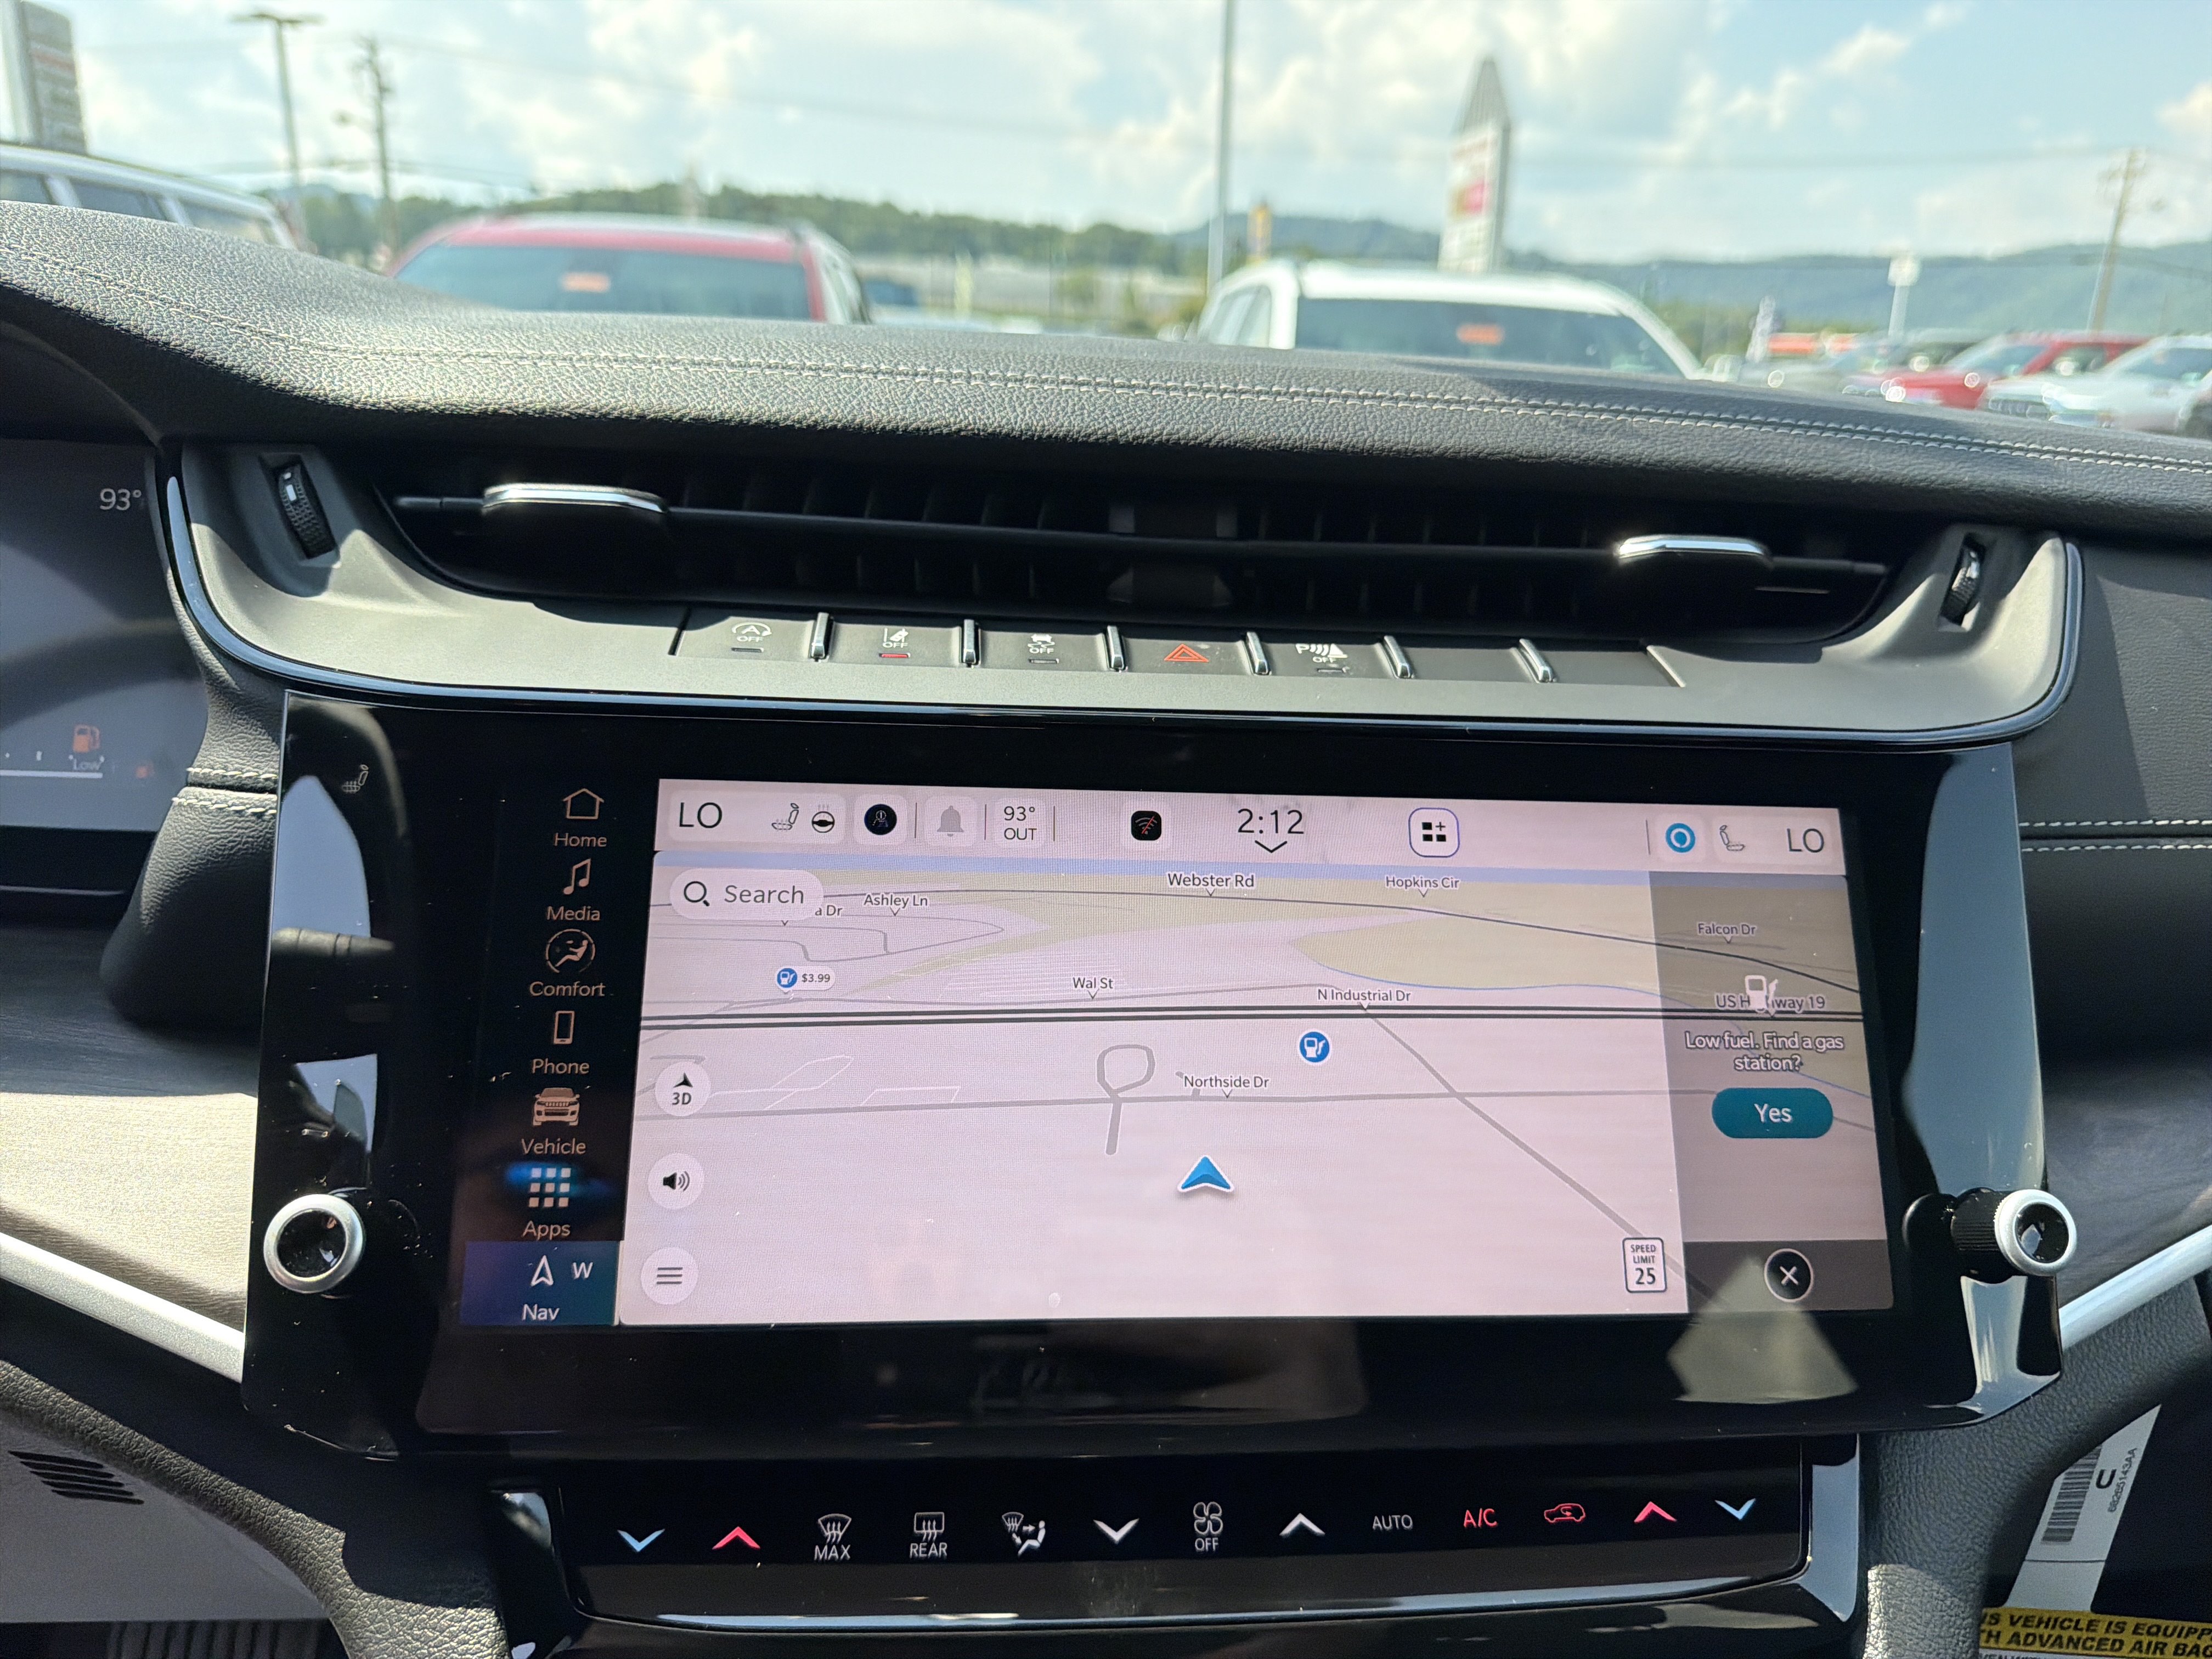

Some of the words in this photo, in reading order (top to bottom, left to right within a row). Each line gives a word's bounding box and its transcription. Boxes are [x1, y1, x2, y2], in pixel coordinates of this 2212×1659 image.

[100, 489, 141, 510] 93°
[679, 803, 722, 828] LO
[1004, 806, 1035, 821] 93°
[1238, 809, 1304, 834] 2:12
[555, 833, 607, 847] Home
[1004, 828, 1037, 840] OUT
[1787, 828, 1824, 853] LO
[1168, 873, 1231, 887] Webster
[1235, 875, 1254, 887] Rd
[1386, 877, 1438, 890] Hopkins
[1442, 878, 1459, 888] Cir
[725, 885, 803, 904] Search
[864, 894, 909, 909] Ashley
[912, 894, 928, 906] Ln
[548, 906, 600, 921] Media
[827, 905, 842, 916] Dr
[1699, 923, 1737, 934] Falcon
[1742, 924, 1755, 934] Dr
[802, 974, 830, 983] $3.99
[1073, 978, 1096, 988] Wal
[1101, 978, 1113, 989] St
[530, 981, 605, 996] Comfort
[1318, 990, 1325, 1000] N
[1331, 989, 1392, 1001] Industrial
[1396, 990, 1410, 1001] Dr
[1717, 995, 1736, 1007] US
[1809, 996, 1825, 1008] 19
[1685, 1032, 1721, 1048] Low
[1724, 1031, 1759, 1048] fuel.
[1763, 1032, 1799, 1048] Find
[1803, 1036, 1812, 1048] a
[1815, 1036, 1844, 1052] gas
[533, 1058, 589, 1074] Phone
[1734, 1054, 1801, 1070] station?
[1185, 1076, 1250, 1087] Northside
[1254, 1076, 1268, 1087] Dr
[673, 1092, 691, 1105] 3D
[1754, 1104, 1792, 1122] Yes
[522, 1138, 585, 1154] Vehicle
[523, 1221, 570, 1240] Apps
[573, 1262, 592, 1278] W
[1636, 1268, 1655, 1284] 25
[523, 1304, 559, 1320] Nav
[1373, 1515, 1412, 1530] AUTO
[1464, 1509, 1497, 1527] A/C
[910, 1543, 947, 1556] REAR
[1195, 1538, 1218, 1550] OFF
[815, 1545, 850, 1559] MAX
[2009, 1614, 2100, 1633] VEHICLE
[2105, 1621, 2127, 1634] IS
[2132, 1622, 2212, 1640] EQUIPP
[2006, 1631, 2124, 1652] ADVANCED
[2129, 1640, 2168, 1656] AIR
